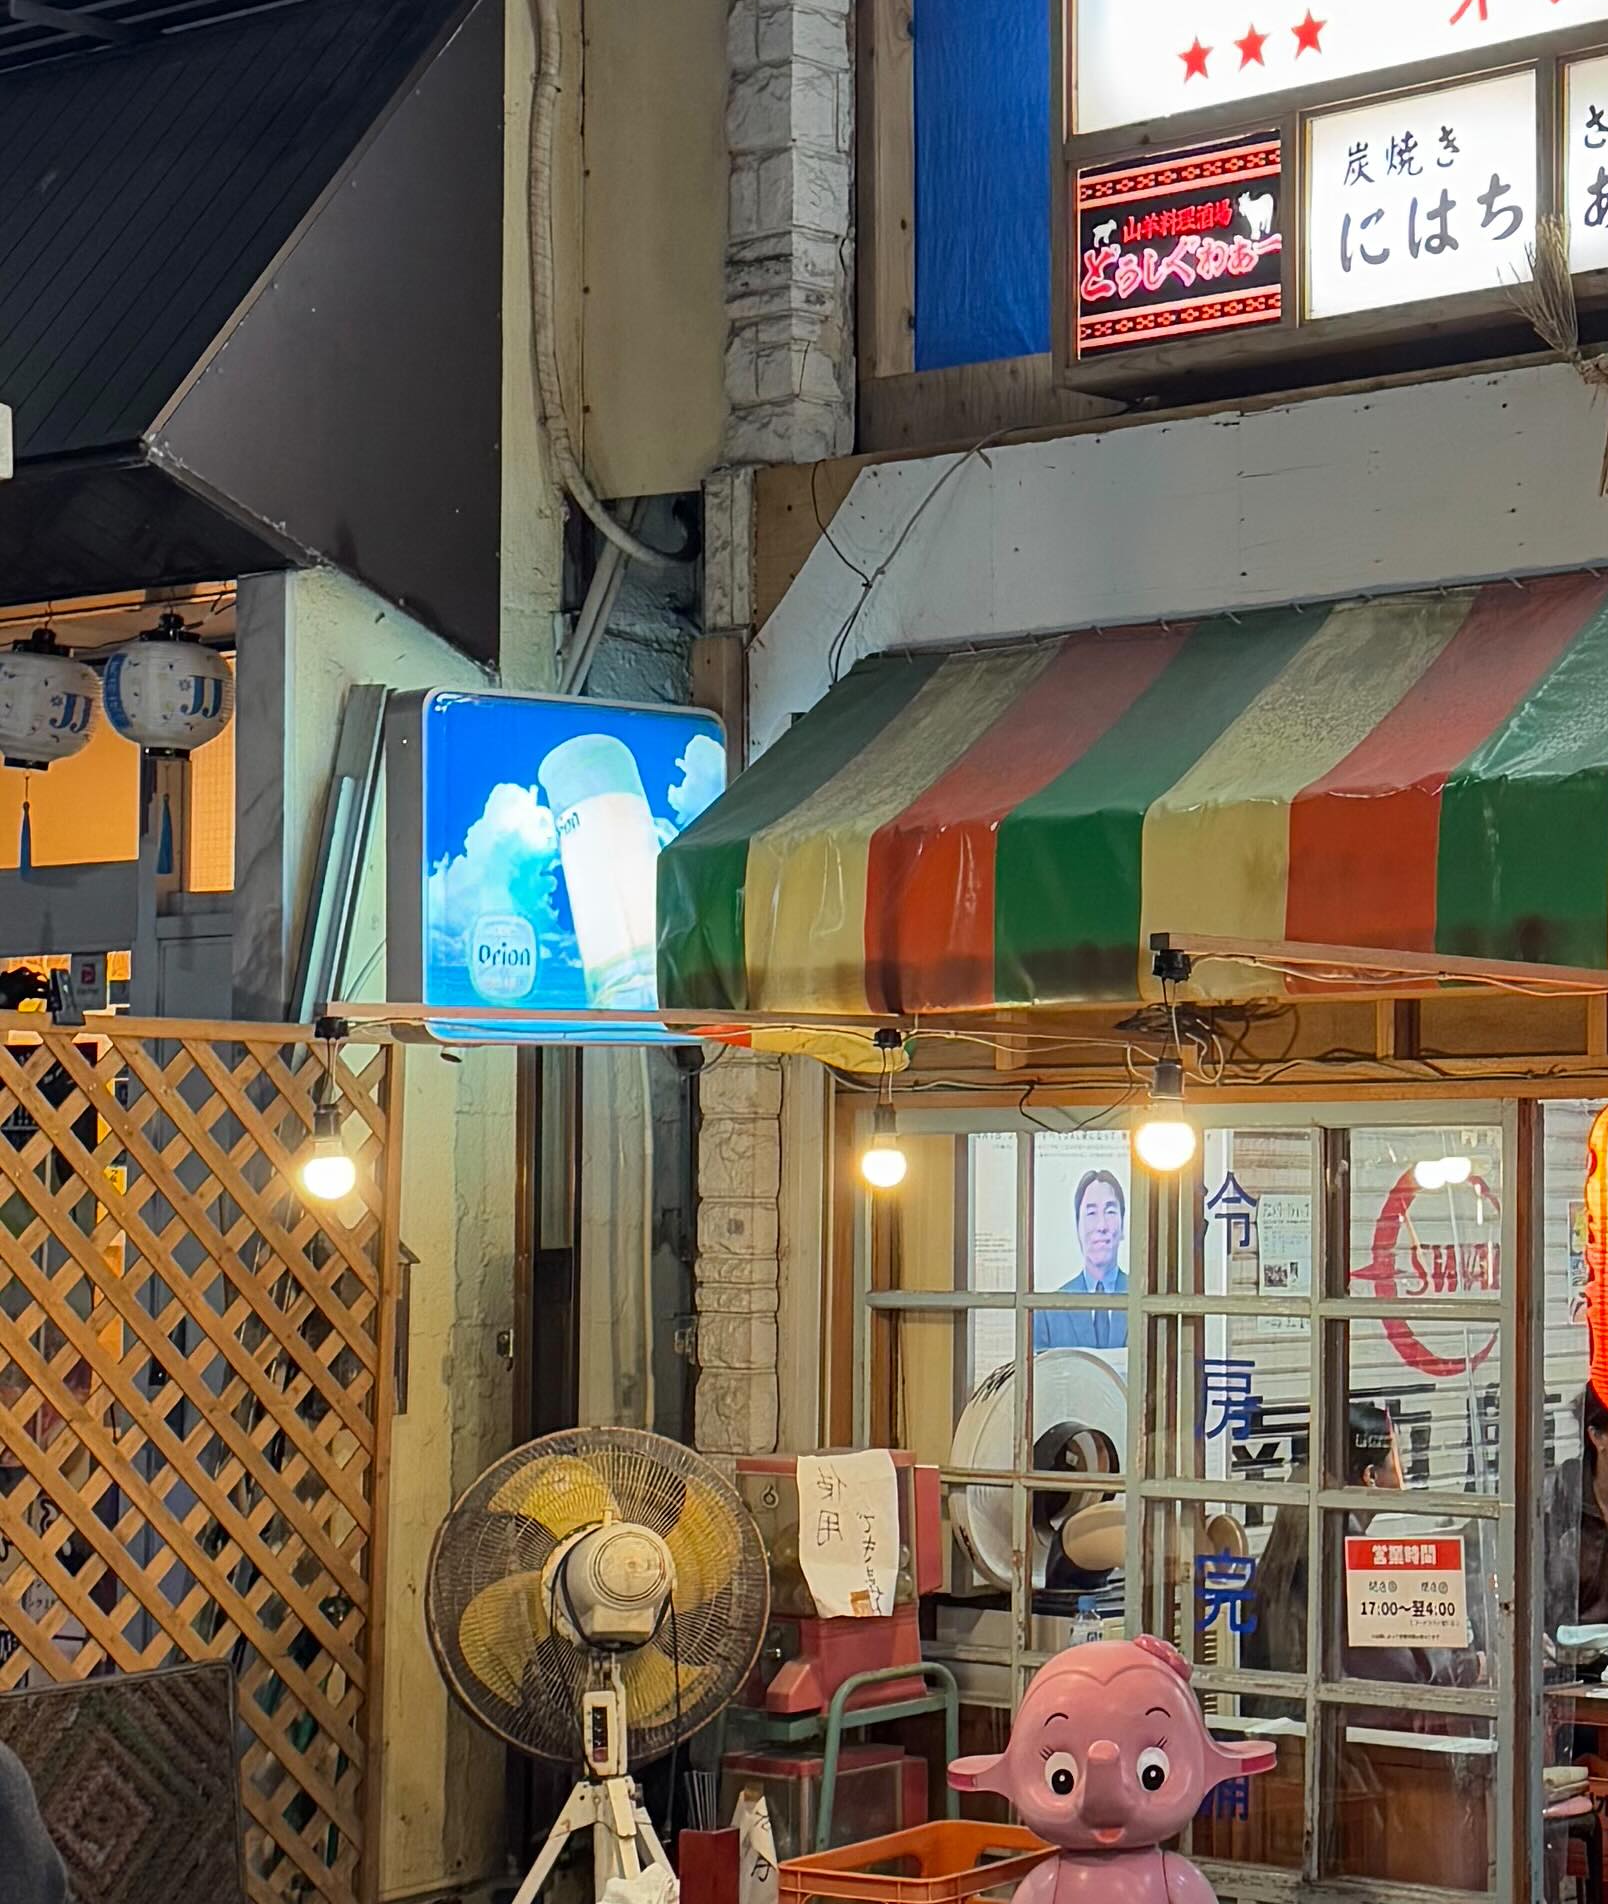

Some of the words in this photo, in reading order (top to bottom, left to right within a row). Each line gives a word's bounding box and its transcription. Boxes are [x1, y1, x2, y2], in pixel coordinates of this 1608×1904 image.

[1342, 124, 1462, 188] 炭焼き
[1339, 172, 1525, 275] にはち
[478, 941, 531, 967] Orion
